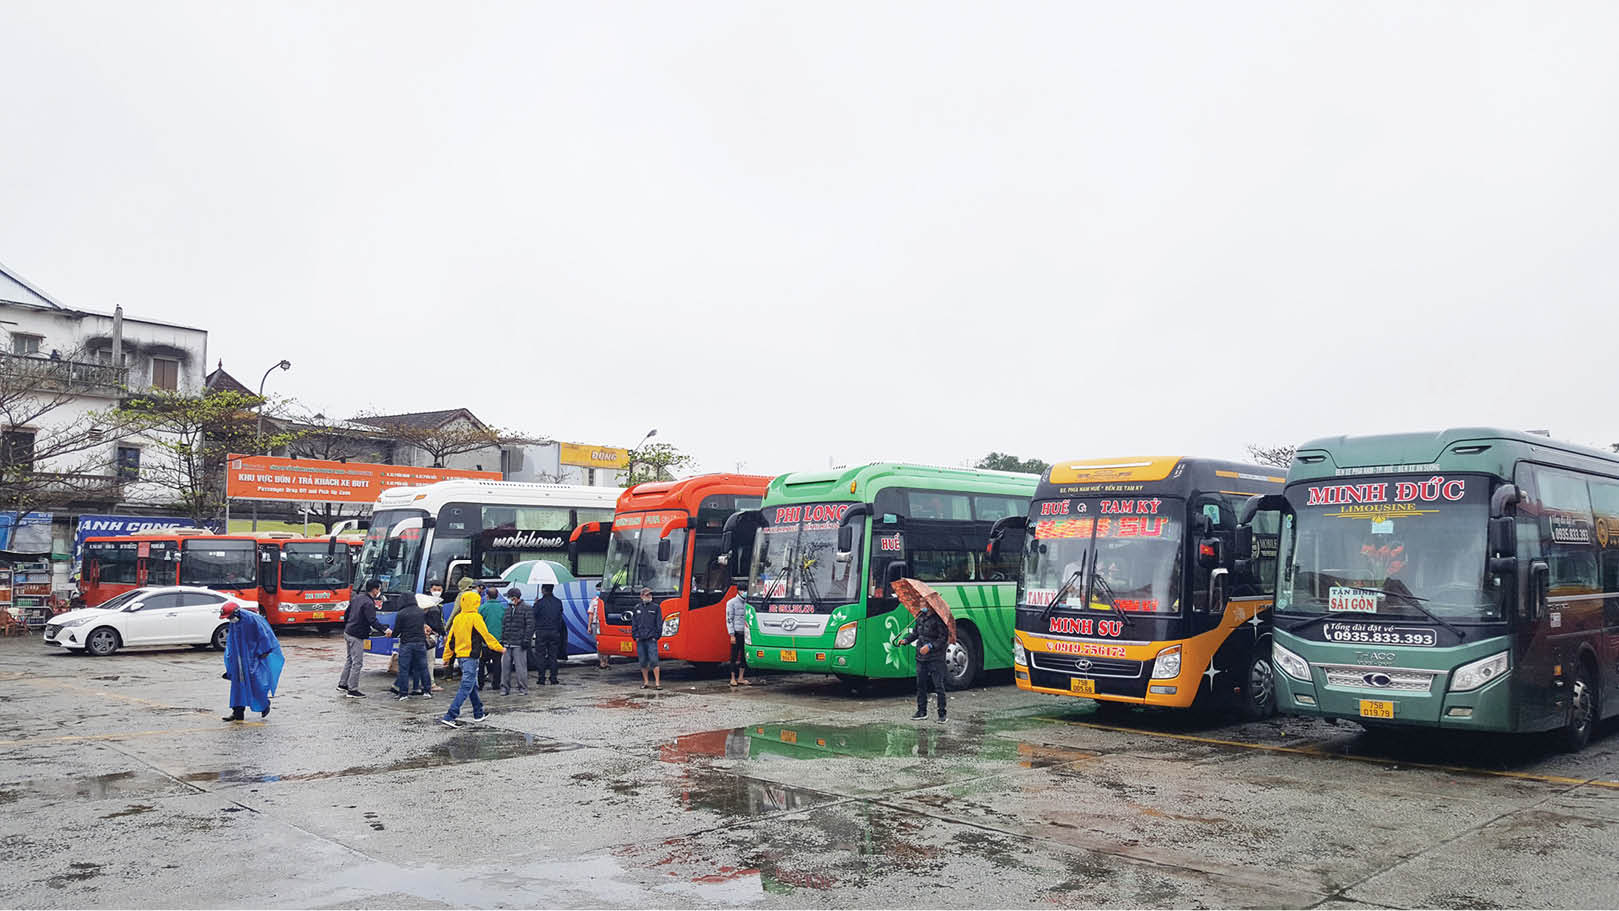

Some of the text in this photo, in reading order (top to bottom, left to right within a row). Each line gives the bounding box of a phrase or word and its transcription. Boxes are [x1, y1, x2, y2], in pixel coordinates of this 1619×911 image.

[1307, 476, 1465, 506] MINH ĐỨC
[1040, 499, 1071, 515] HUẾ
[1100, 500, 1134, 514] TAM
[1340, 503, 1416, 513] LIMOUSINE
[775, 508, 801, 524] PHI
[492, 531, 565, 548] mobihome
[881, 532, 900, 550] HUẾ
[1027, 591, 1044, 605] TAM
[1330, 595, 1374, 610] SÀI GÒN
[1049, 617, 1124, 637] MINH SƯ
[1330, 623, 1351, 632] Tổng
[1367, 624, 1382, 633] đặt
[1333, 631, 1433, 644] 0935.833.393
[1055, 642, 1126, 657] 0919.756172
